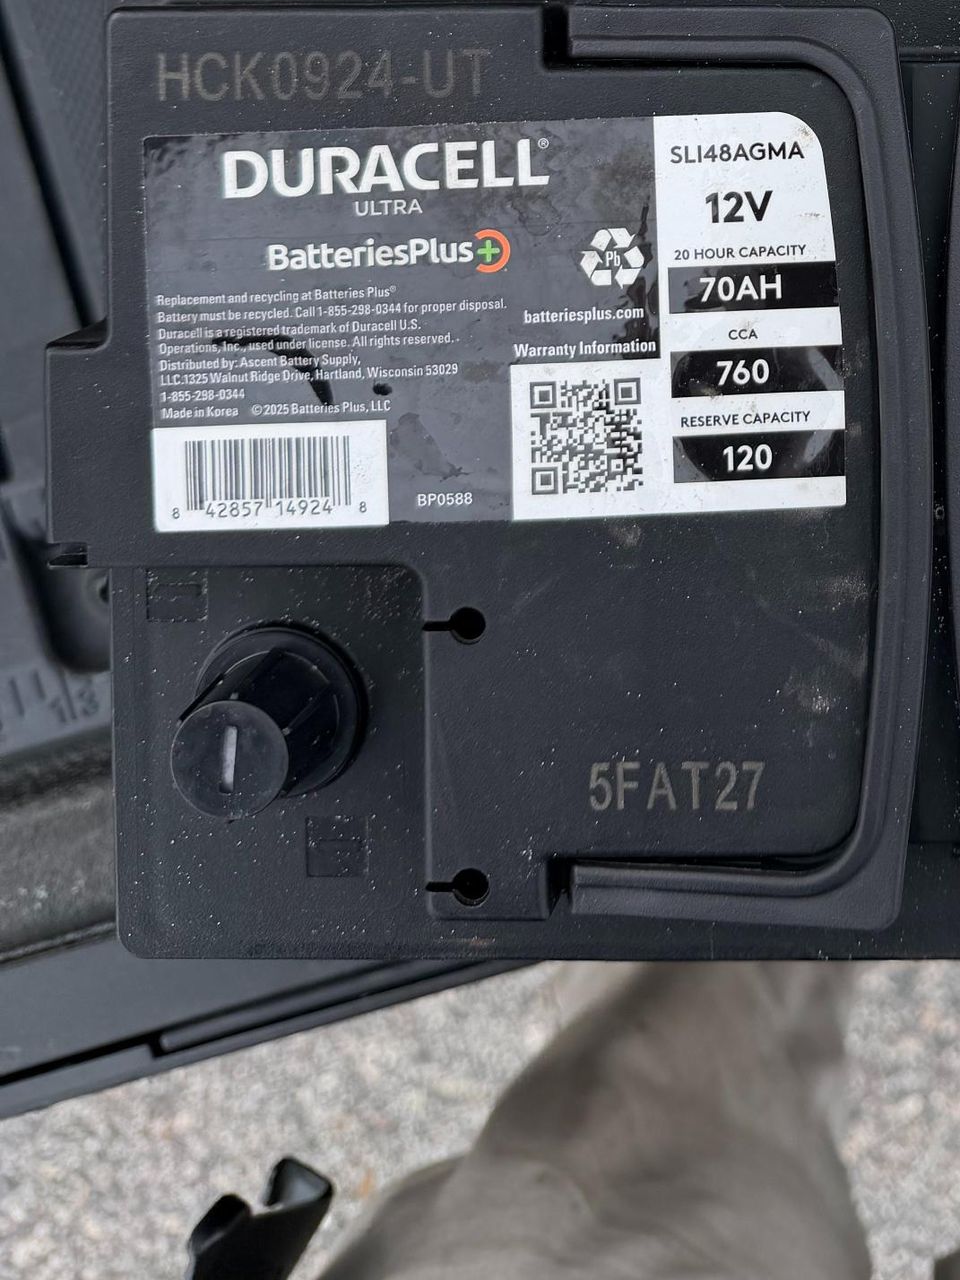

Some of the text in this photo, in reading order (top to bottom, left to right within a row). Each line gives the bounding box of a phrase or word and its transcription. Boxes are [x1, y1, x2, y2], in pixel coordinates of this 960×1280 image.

[157, 48, 490, 101] HCK0924-UT
[670, 142, 804, 165] SLI48AGMA
[355, 199, 423, 216] ULTRA
[705, 191, 773, 224] 12V
[606, 251, 620, 266] Pb
[674, 245, 806, 261] 20 HOUR CAPACITY
[699, 274, 782, 303] 70AH
[524, 307, 644, 323] batteriesplus.com
[729, 329, 758, 340] CCA
[514, 340, 656, 359] Warranty Information
[716, 360, 769, 386] 760
[160, 388, 245, 402] 1-855-298-0344
[162, 406, 239, 419] Made in Korea
[680, 411, 810, 428] RESERVE CAPACITY
[723, 445, 773, 472] 120
[418, 492, 473, 506] BP0588
[172, 499, 367, 519] 8 42857 14924 8
